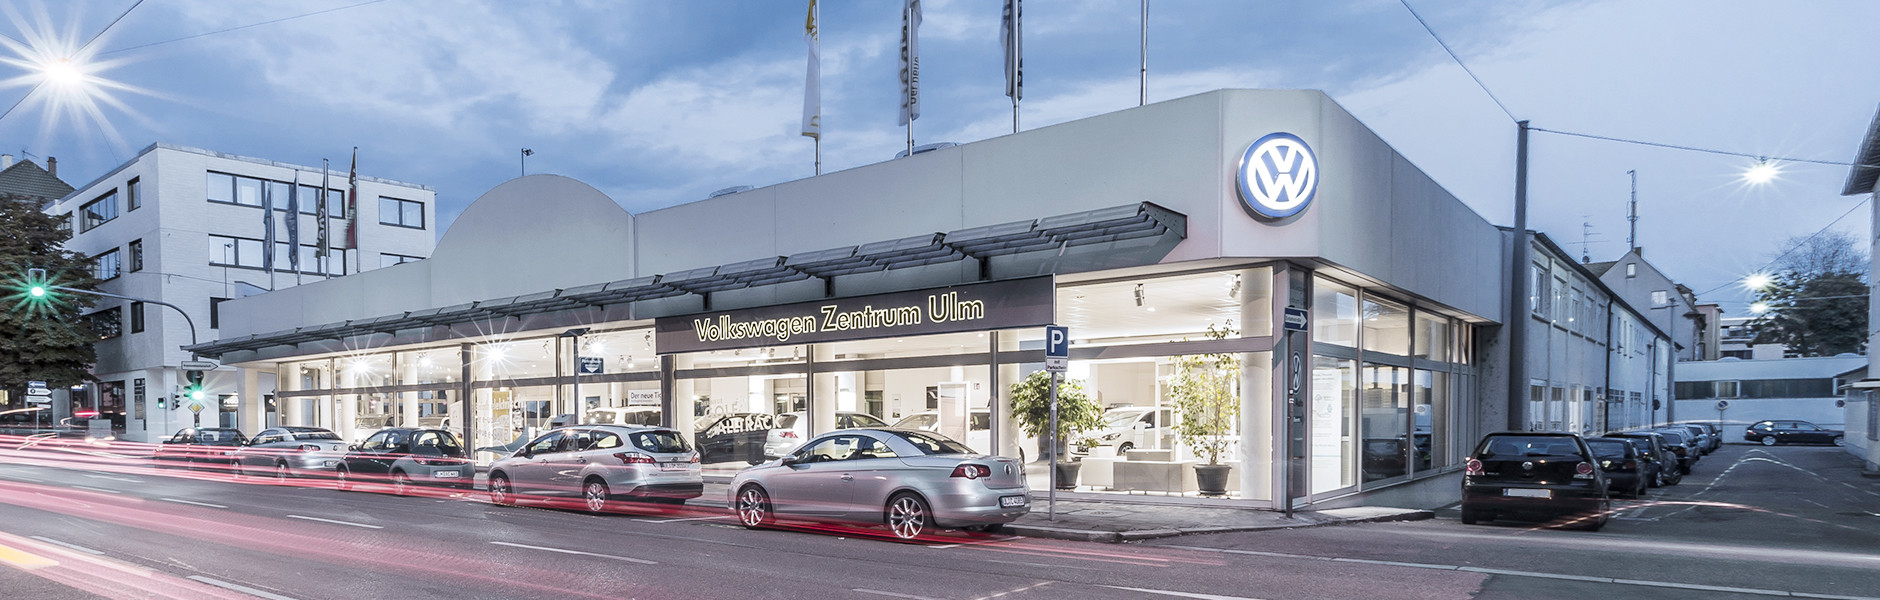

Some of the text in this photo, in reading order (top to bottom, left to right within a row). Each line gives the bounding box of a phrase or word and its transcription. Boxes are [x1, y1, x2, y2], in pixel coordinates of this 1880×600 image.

[1246, 138, 1316, 210] VW
[694, 291, 985, 342] Volkswagen Zentrum Ulm
[1050, 329, 1064, 353] P
[630, 391, 640, 399] Der
[717, 414, 784, 435] ALLTRACK
